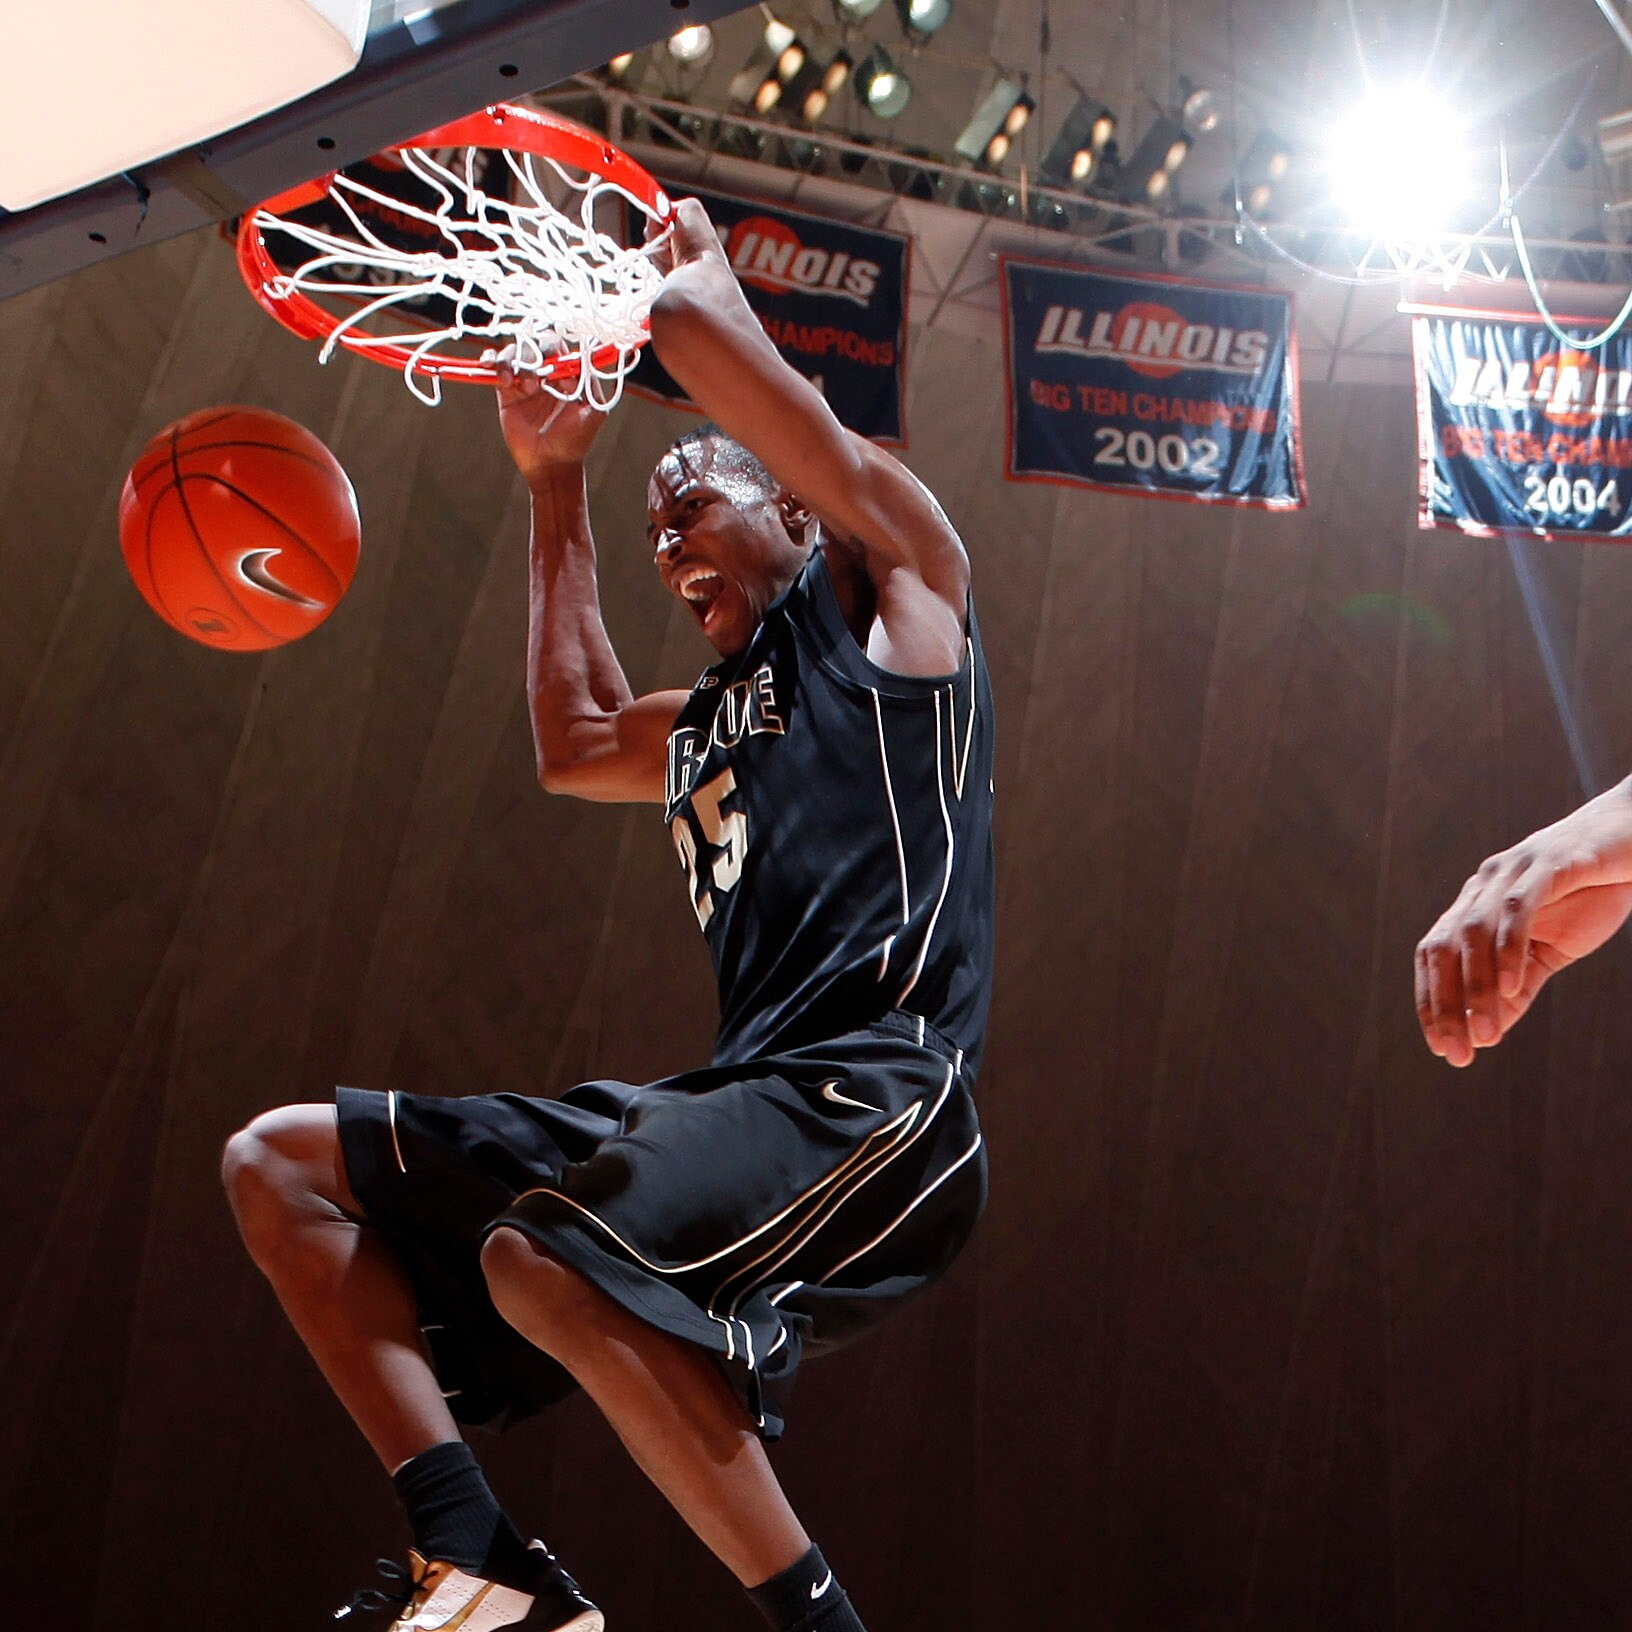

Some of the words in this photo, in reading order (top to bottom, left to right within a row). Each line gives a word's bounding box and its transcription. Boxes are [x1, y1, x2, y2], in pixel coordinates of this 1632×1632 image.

[1036, 305, 1269, 370] ILLINOIS
[1030, 379, 1070, 411] BIG
[1078, 387, 1128, 416] TEN
[1094, 427, 1220, 478] 2002
[1523, 476, 1621, 516] 2004
